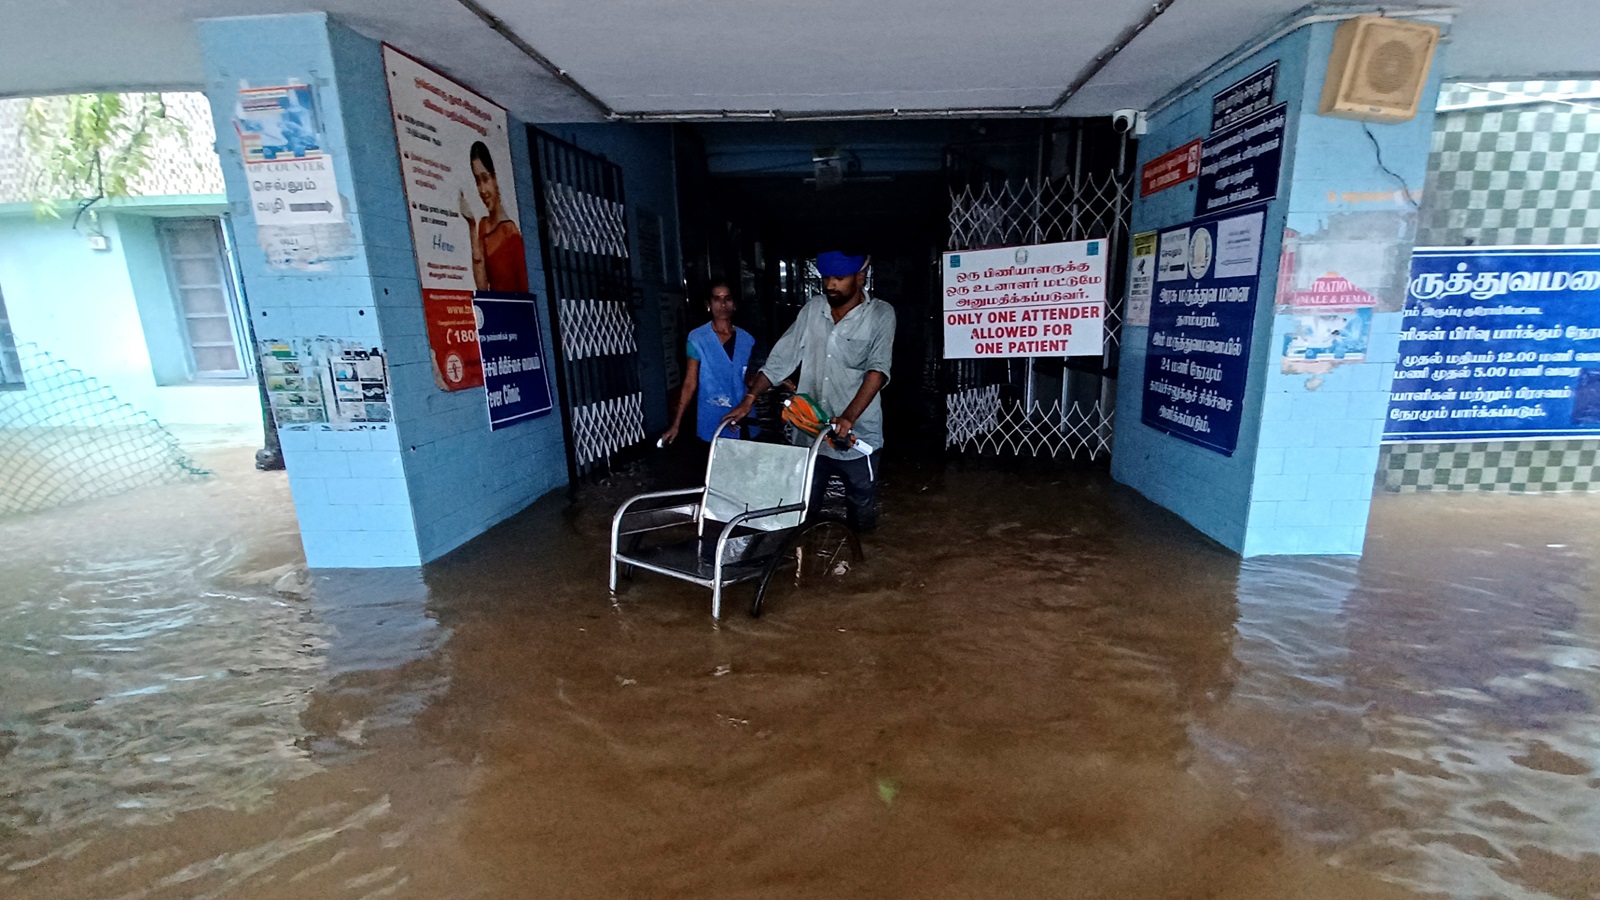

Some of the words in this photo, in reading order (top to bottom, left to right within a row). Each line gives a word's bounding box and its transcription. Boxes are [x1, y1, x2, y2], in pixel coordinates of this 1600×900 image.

[266, 161, 326, 172] COUNTER
[252, 177, 317, 194] செல்லும்
[256, 198, 286, 214] வழி
[946, 286, 970, 296] ஒரு
[1044, 274, 1102, 288] மட்டுமே
[956, 272, 980, 282] ஒரு
[948, 313, 982, 326] ONLY
[988, 311, 1016, 324] ONE
[1022, 306, 1100, 322] ATTENDER
[970, 325, 1038, 340] ALLOWED
[1044, 324, 1072, 336] FOR
[1449, 326, 1490, 342] பிரிவு
[974, 342, 1003, 354] ONE
[1008, 340, 1068, 353] PATIENT
[1160, 358, 1170, 370] 24
[1496, 352, 1537, 362] 12.00
[1474, 366, 1508, 378] 5.00
[487, 388, 502, 408] ever
[502, 383, 521, 404] Clinic
[1460, 386, 1513, 402] மற்றும்
